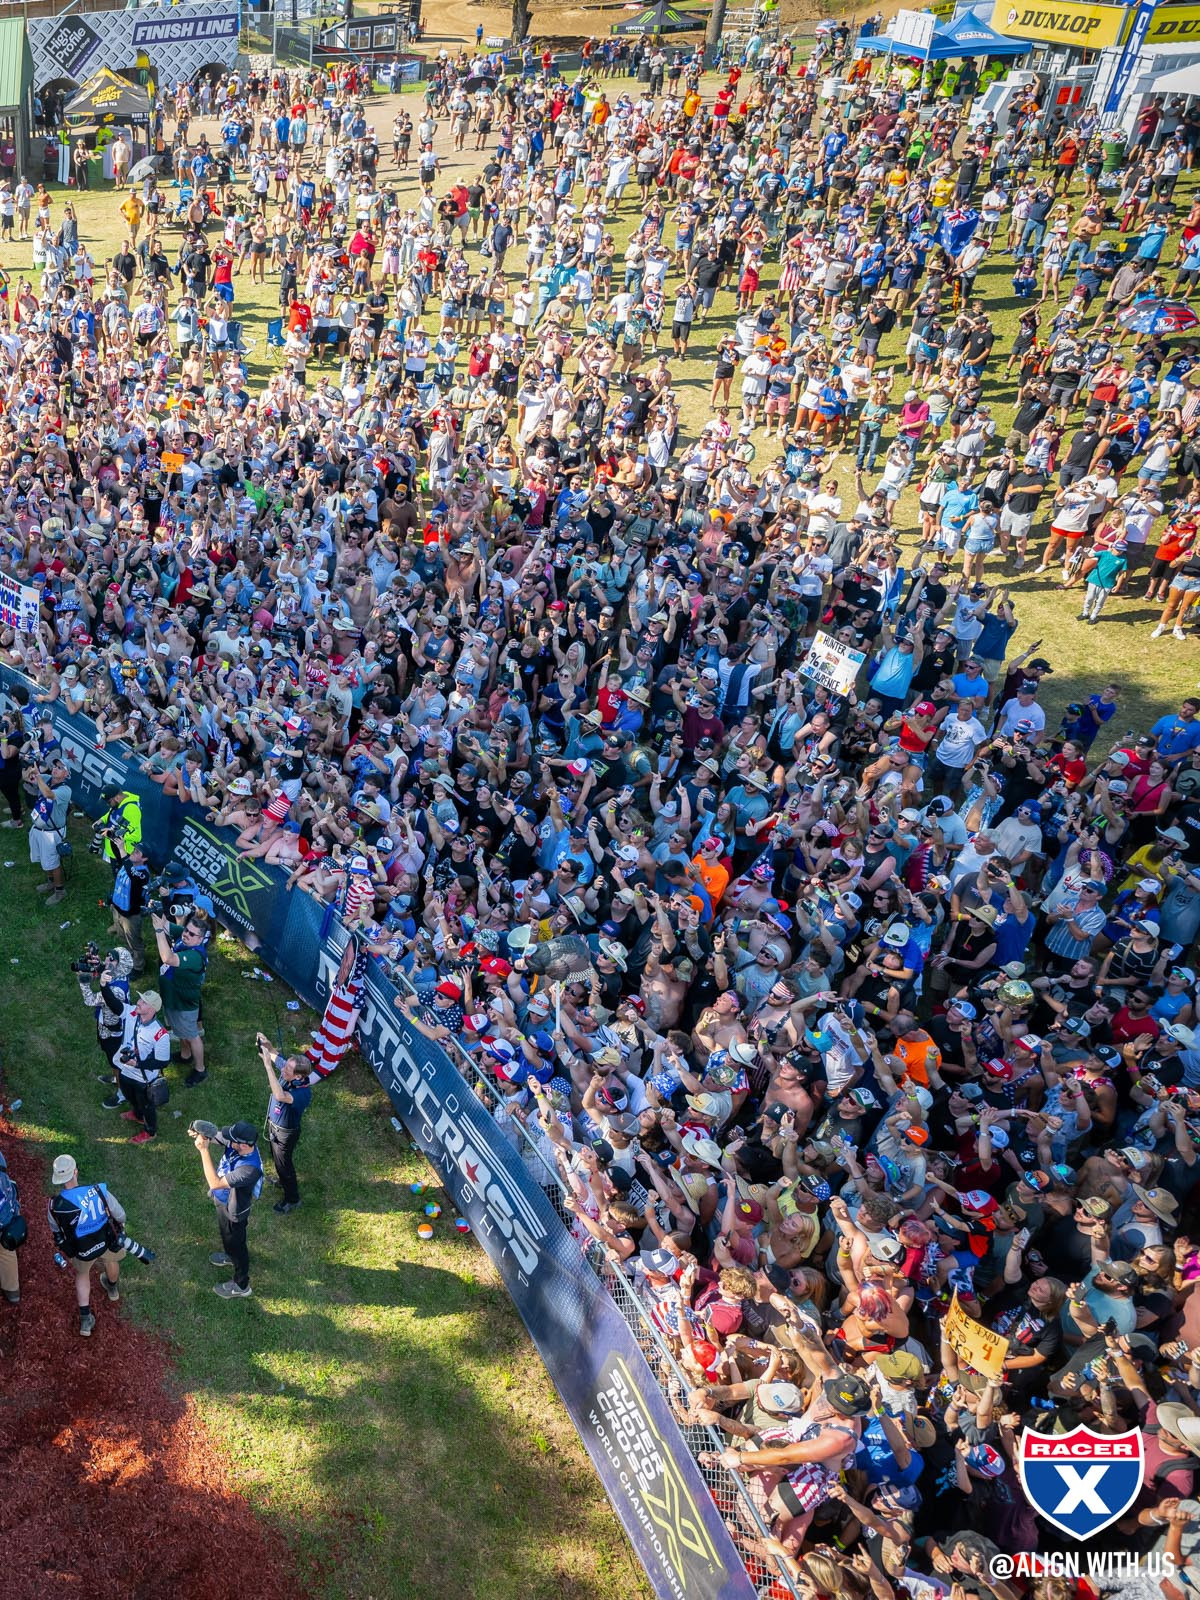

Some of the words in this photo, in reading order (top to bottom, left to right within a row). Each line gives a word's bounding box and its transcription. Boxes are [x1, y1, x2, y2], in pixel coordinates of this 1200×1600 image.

[47, 27, 72, 55] High
[135, 22, 194, 42] FINISH
[197, 18, 236, 36] LINE
[1018, 10, 1101, 34] DUNLOP
[55, 27, 88, 64] Profile
[810, 651, 821, 667] 96
[823, 635, 847, 656] HUNTER
[180, 837, 221, 874] MOTO
[181, 824, 227, 867] SUPER
[173, 845, 218, 885] CROSS
[197, 883, 255, 932] CHAMPIONSHIP
[315, 983, 530, 1288] CAMPIONSHIP
[982, 1343, 993, 1361] 4
[606, 1387, 657, 1481] MOTO
[609, 1368, 666, 1476] SUPER
[597, 1391, 651, 1493] CROSS
[588, 1409, 621, 1469] WORLD
[619, 1471, 686, 1600] CHAMPIONSHI
